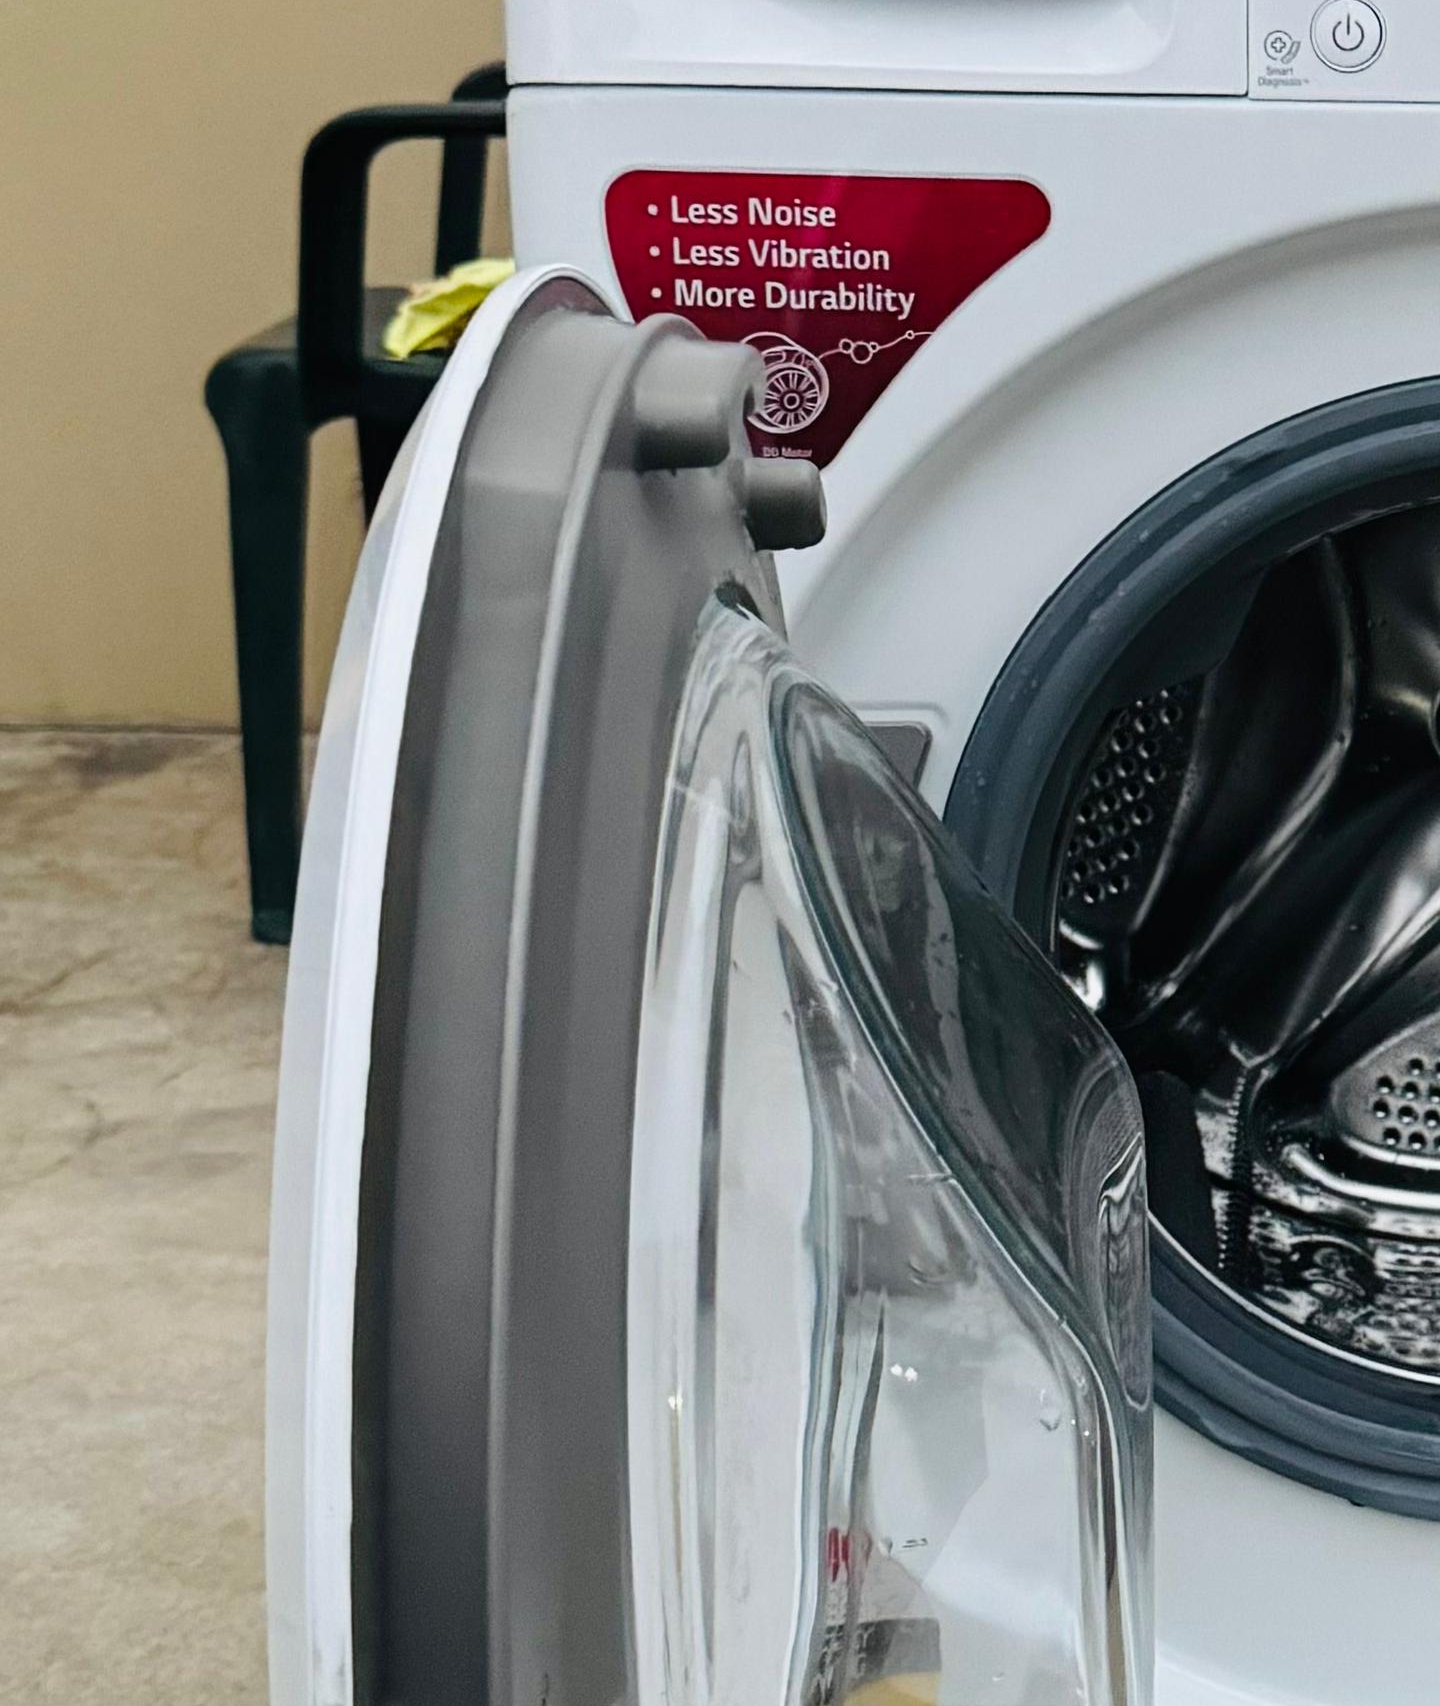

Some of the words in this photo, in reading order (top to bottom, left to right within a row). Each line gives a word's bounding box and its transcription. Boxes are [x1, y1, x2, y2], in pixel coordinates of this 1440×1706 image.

[671, 196, 738, 225] Less
[749, 198, 836, 227] Noise
[673, 237, 740, 266] Less
[748, 239, 890, 270] Vibration
[674, 280, 755, 308] More
[766, 281, 915, 320] Durability
